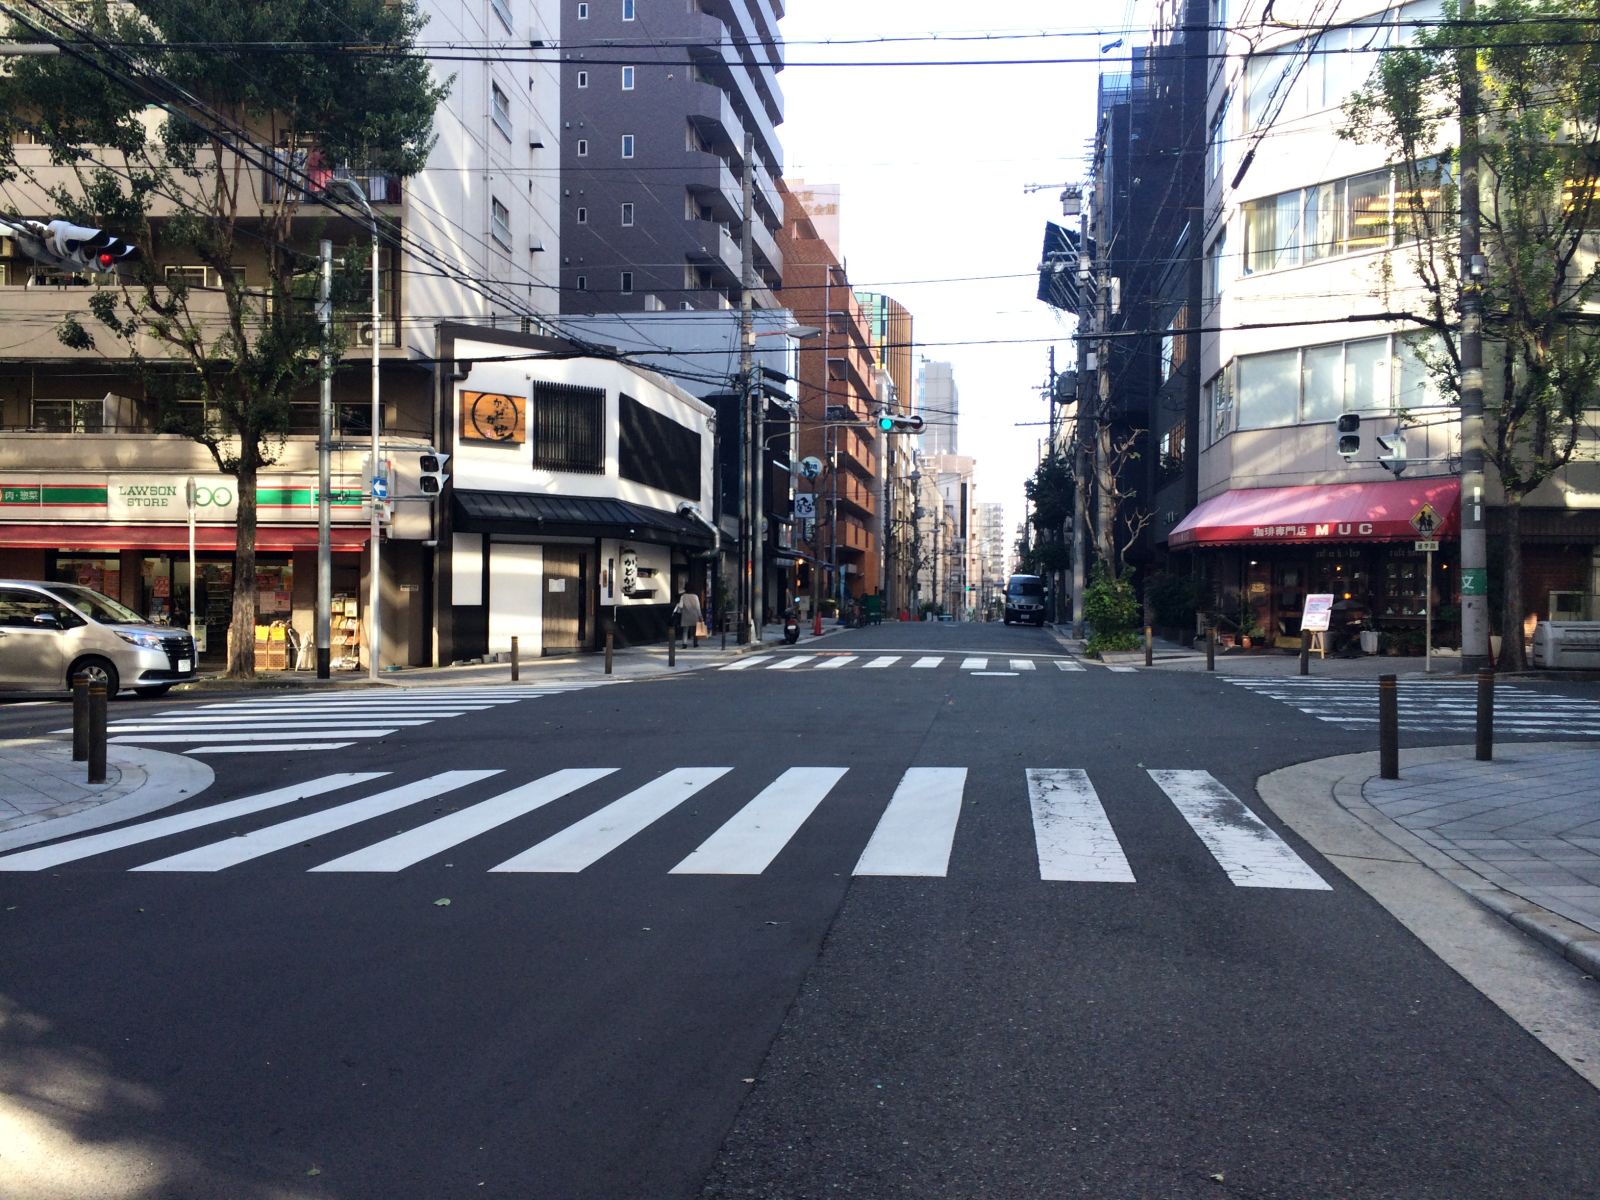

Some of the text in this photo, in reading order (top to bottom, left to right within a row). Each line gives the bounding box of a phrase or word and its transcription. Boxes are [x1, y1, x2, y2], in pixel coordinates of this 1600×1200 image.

[119, 485, 177, 496] LAWSON
[127, 498, 169, 507] STORE
[1253, 525, 1307, 537] 珈琲専門店
[1461, 575, 1475, 590] 文
